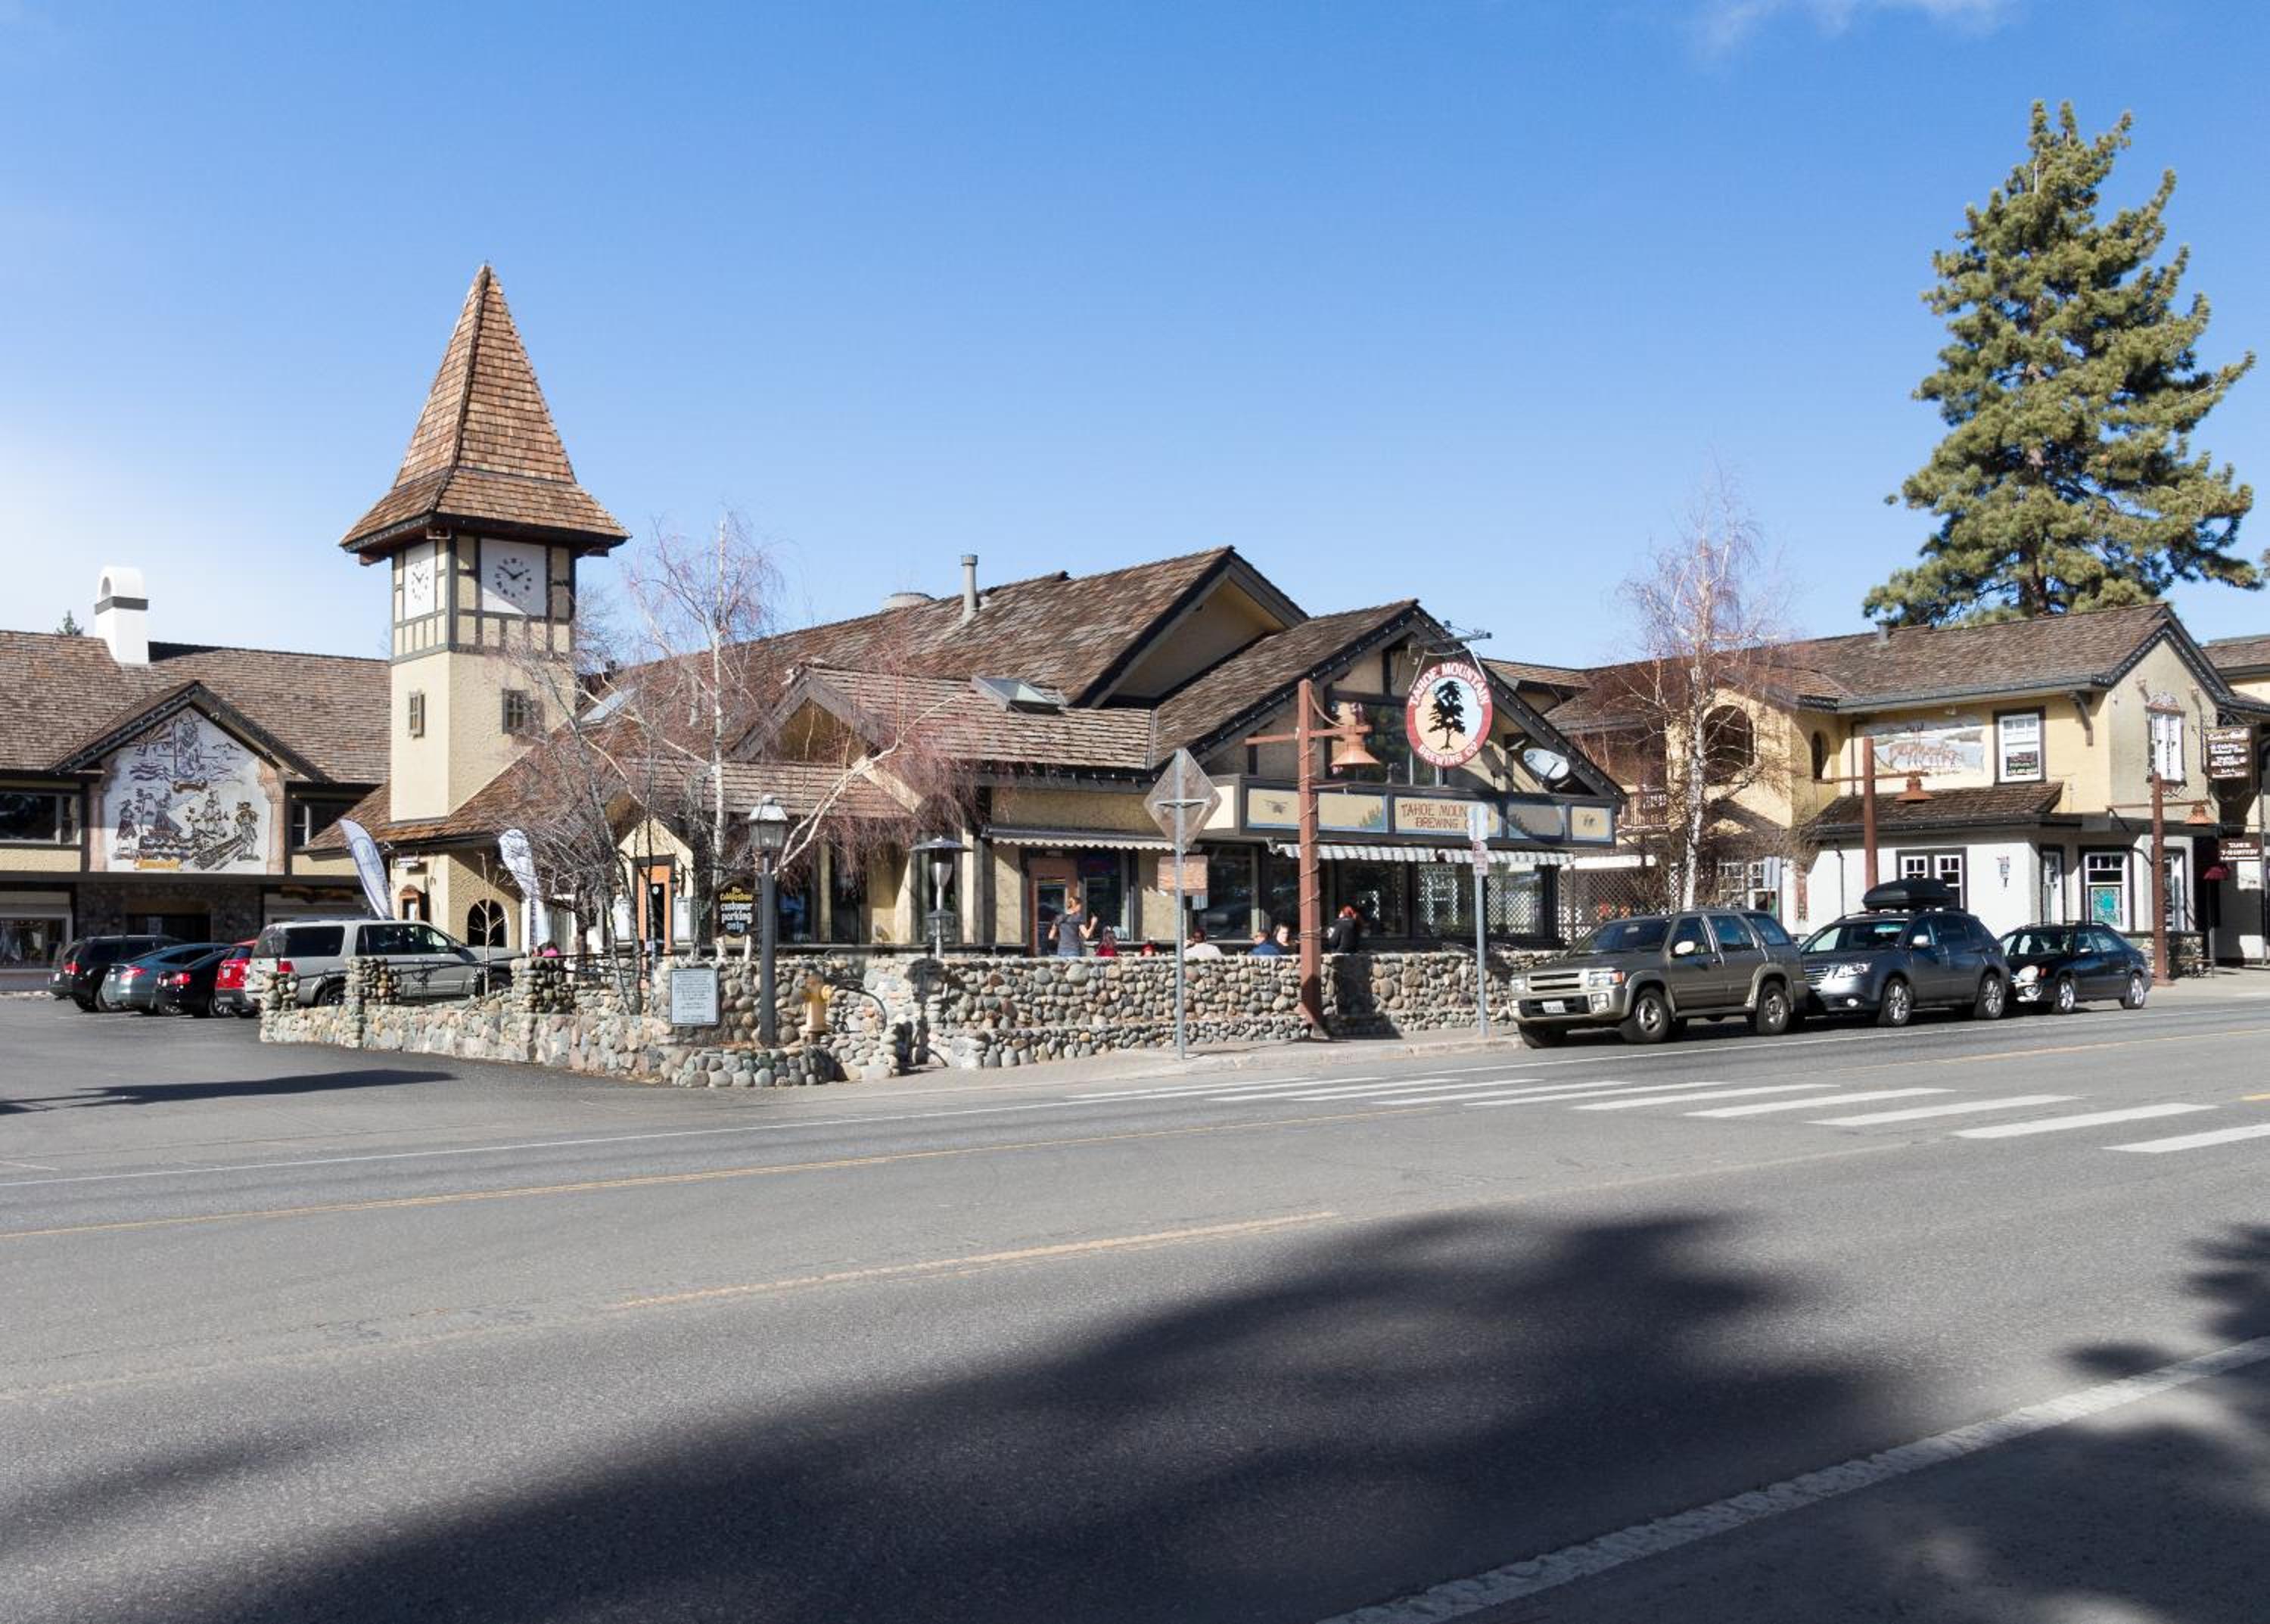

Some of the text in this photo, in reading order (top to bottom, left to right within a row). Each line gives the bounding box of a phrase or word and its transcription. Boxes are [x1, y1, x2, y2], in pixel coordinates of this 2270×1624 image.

[1409, 662, 1490, 705] TAHOE MOUNTAIN
[1417, 744, 1463, 764] BREWING
[1401, 802, 1435, 817] TAHOE
[1416, 817, 1458, 829] BREWING
[720, 901, 753, 912] customer
[721, 910, 753, 924] parking
[726, 921, 745, 933] only
